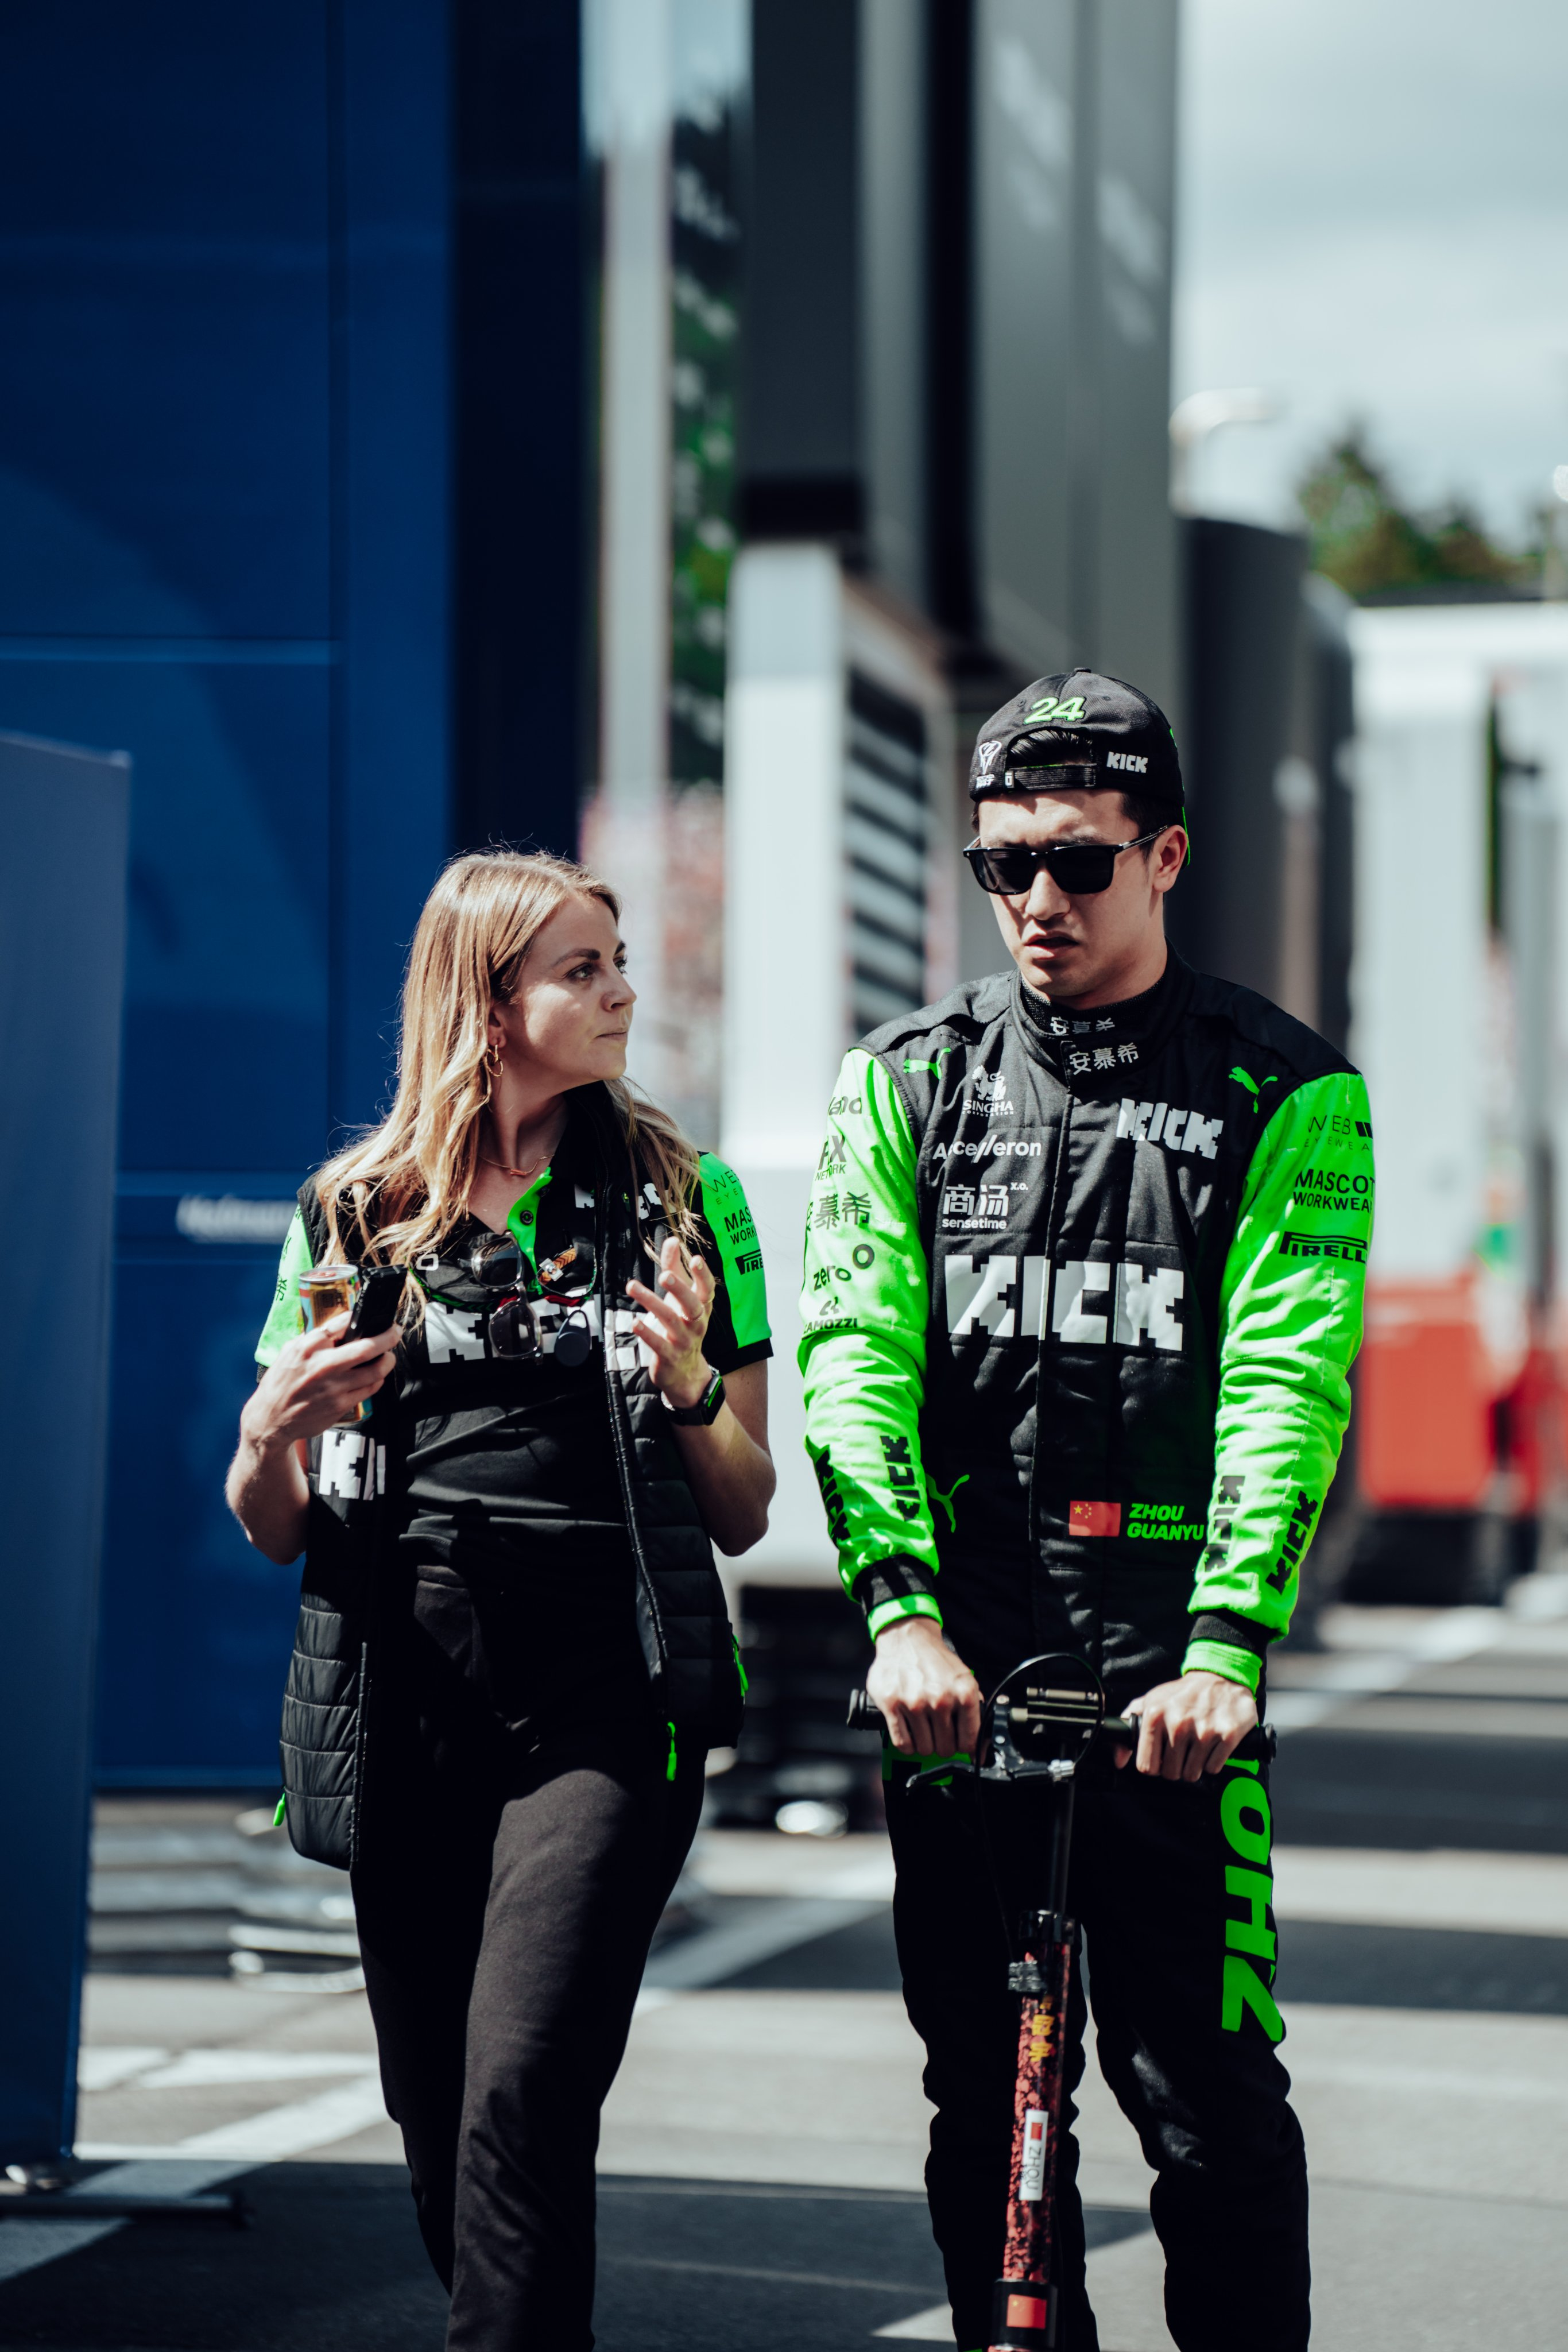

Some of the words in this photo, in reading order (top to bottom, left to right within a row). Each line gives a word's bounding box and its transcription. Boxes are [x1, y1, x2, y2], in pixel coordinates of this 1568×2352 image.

[1024, 696, 1086, 725] 24
[1106, 751, 1148, 773] KICK
[1069, 1042, 1139, 1076] 安慕希
[962, 1099, 1014, 1113] SINGHA
[1308, 1115, 1350, 1135] WEB
[1304, 1136, 1370, 1151] EYEWEA
[707, 1169, 740, 1193] WE
[943, 1183, 1009, 1217] 商汤
[1292, 1192, 1372, 1214] WORKWEA
[724, 1206, 753, 1233] MAS
[942, 1218, 1007, 1229] sensetime
[730, 1224, 758, 1245] WORK
[1279, 1231, 1368, 1265] PIRELL
[734, 1248, 764, 1275] PIRE
[814, 1265, 851, 1291] zero
[944, 1255, 1184, 1351] KICK
[880, 1436, 921, 1522] KICK
[1129, 1503, 1184, 1521] ZHOU
[1205, 1476, 1245, 1573] KICK
[1127, 1522, 1204, 1540] GUANYU
[1265, 1490, 1318, 1595] KICK
[1027, 2145, 1042, 2189] ZHOU
